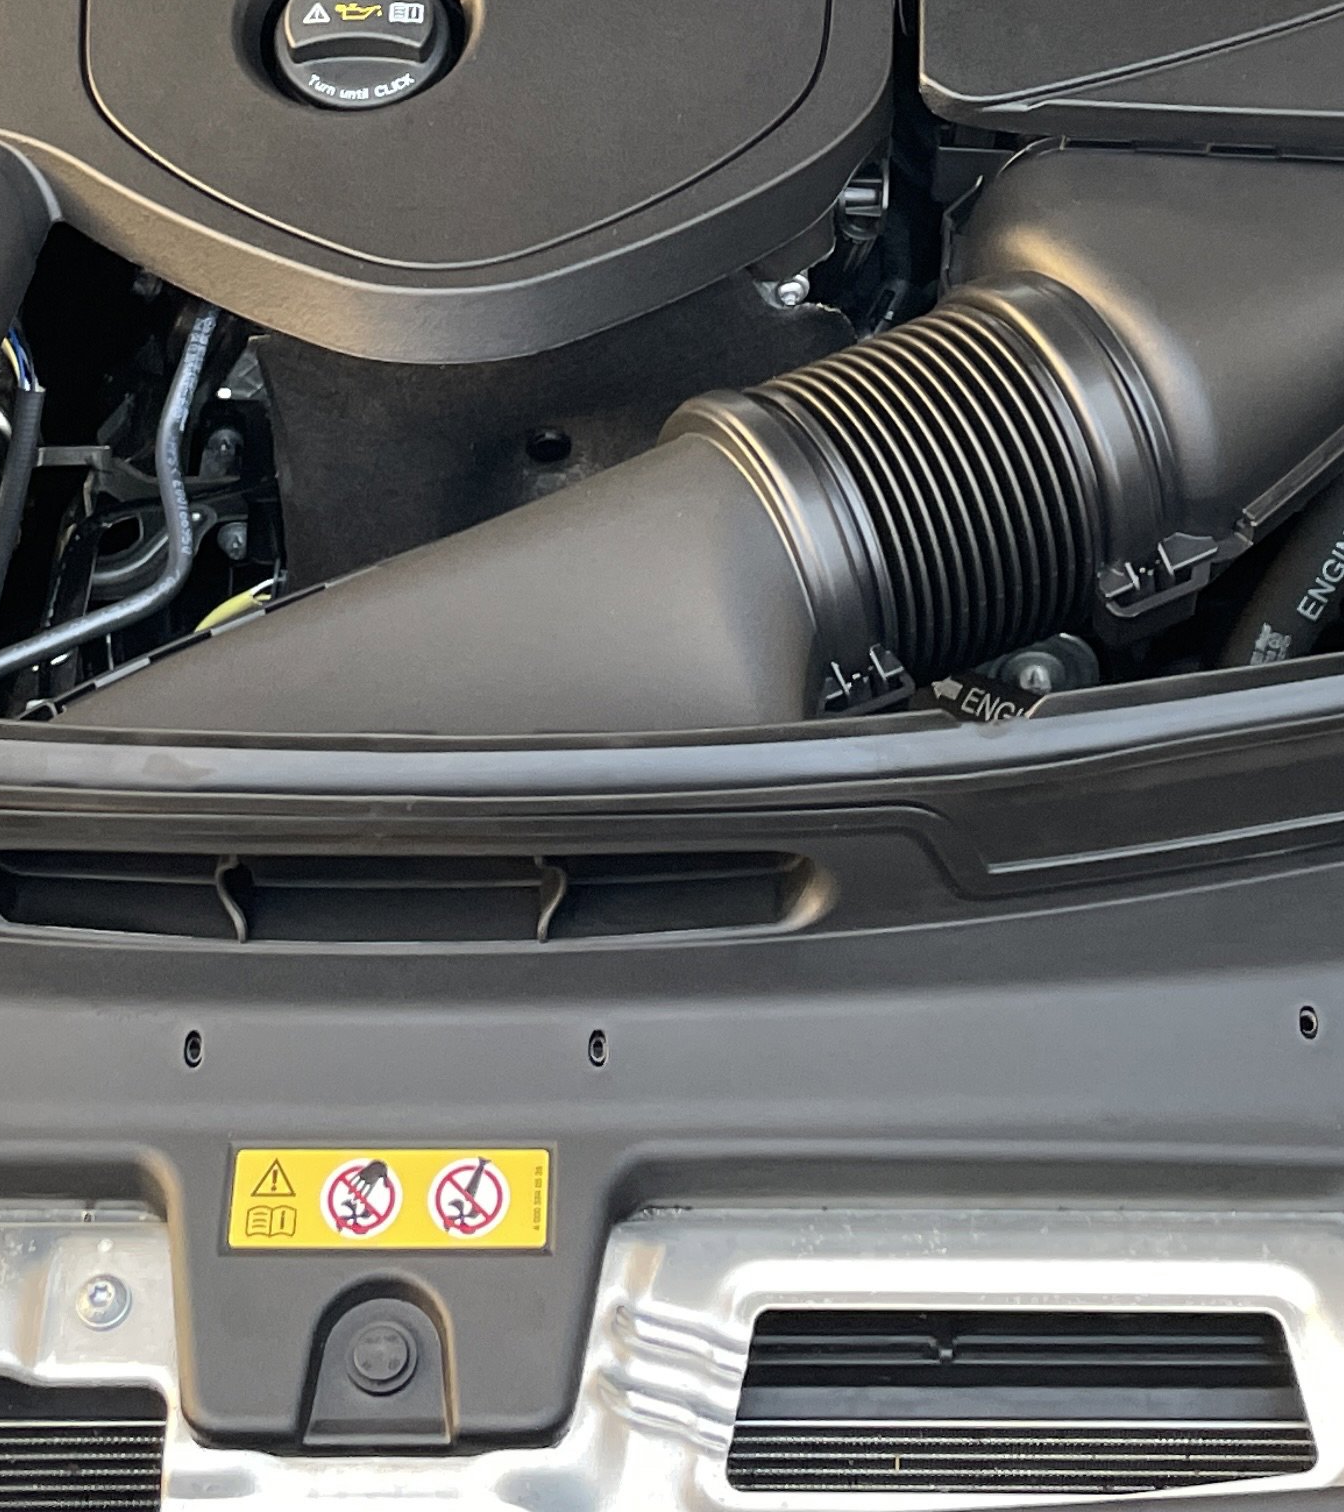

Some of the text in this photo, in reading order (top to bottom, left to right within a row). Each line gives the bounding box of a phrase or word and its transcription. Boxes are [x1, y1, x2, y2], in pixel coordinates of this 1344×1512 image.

[309, 73, 415, 99] Turn until CLICK
[961, 688, 1024, 721] ENG
